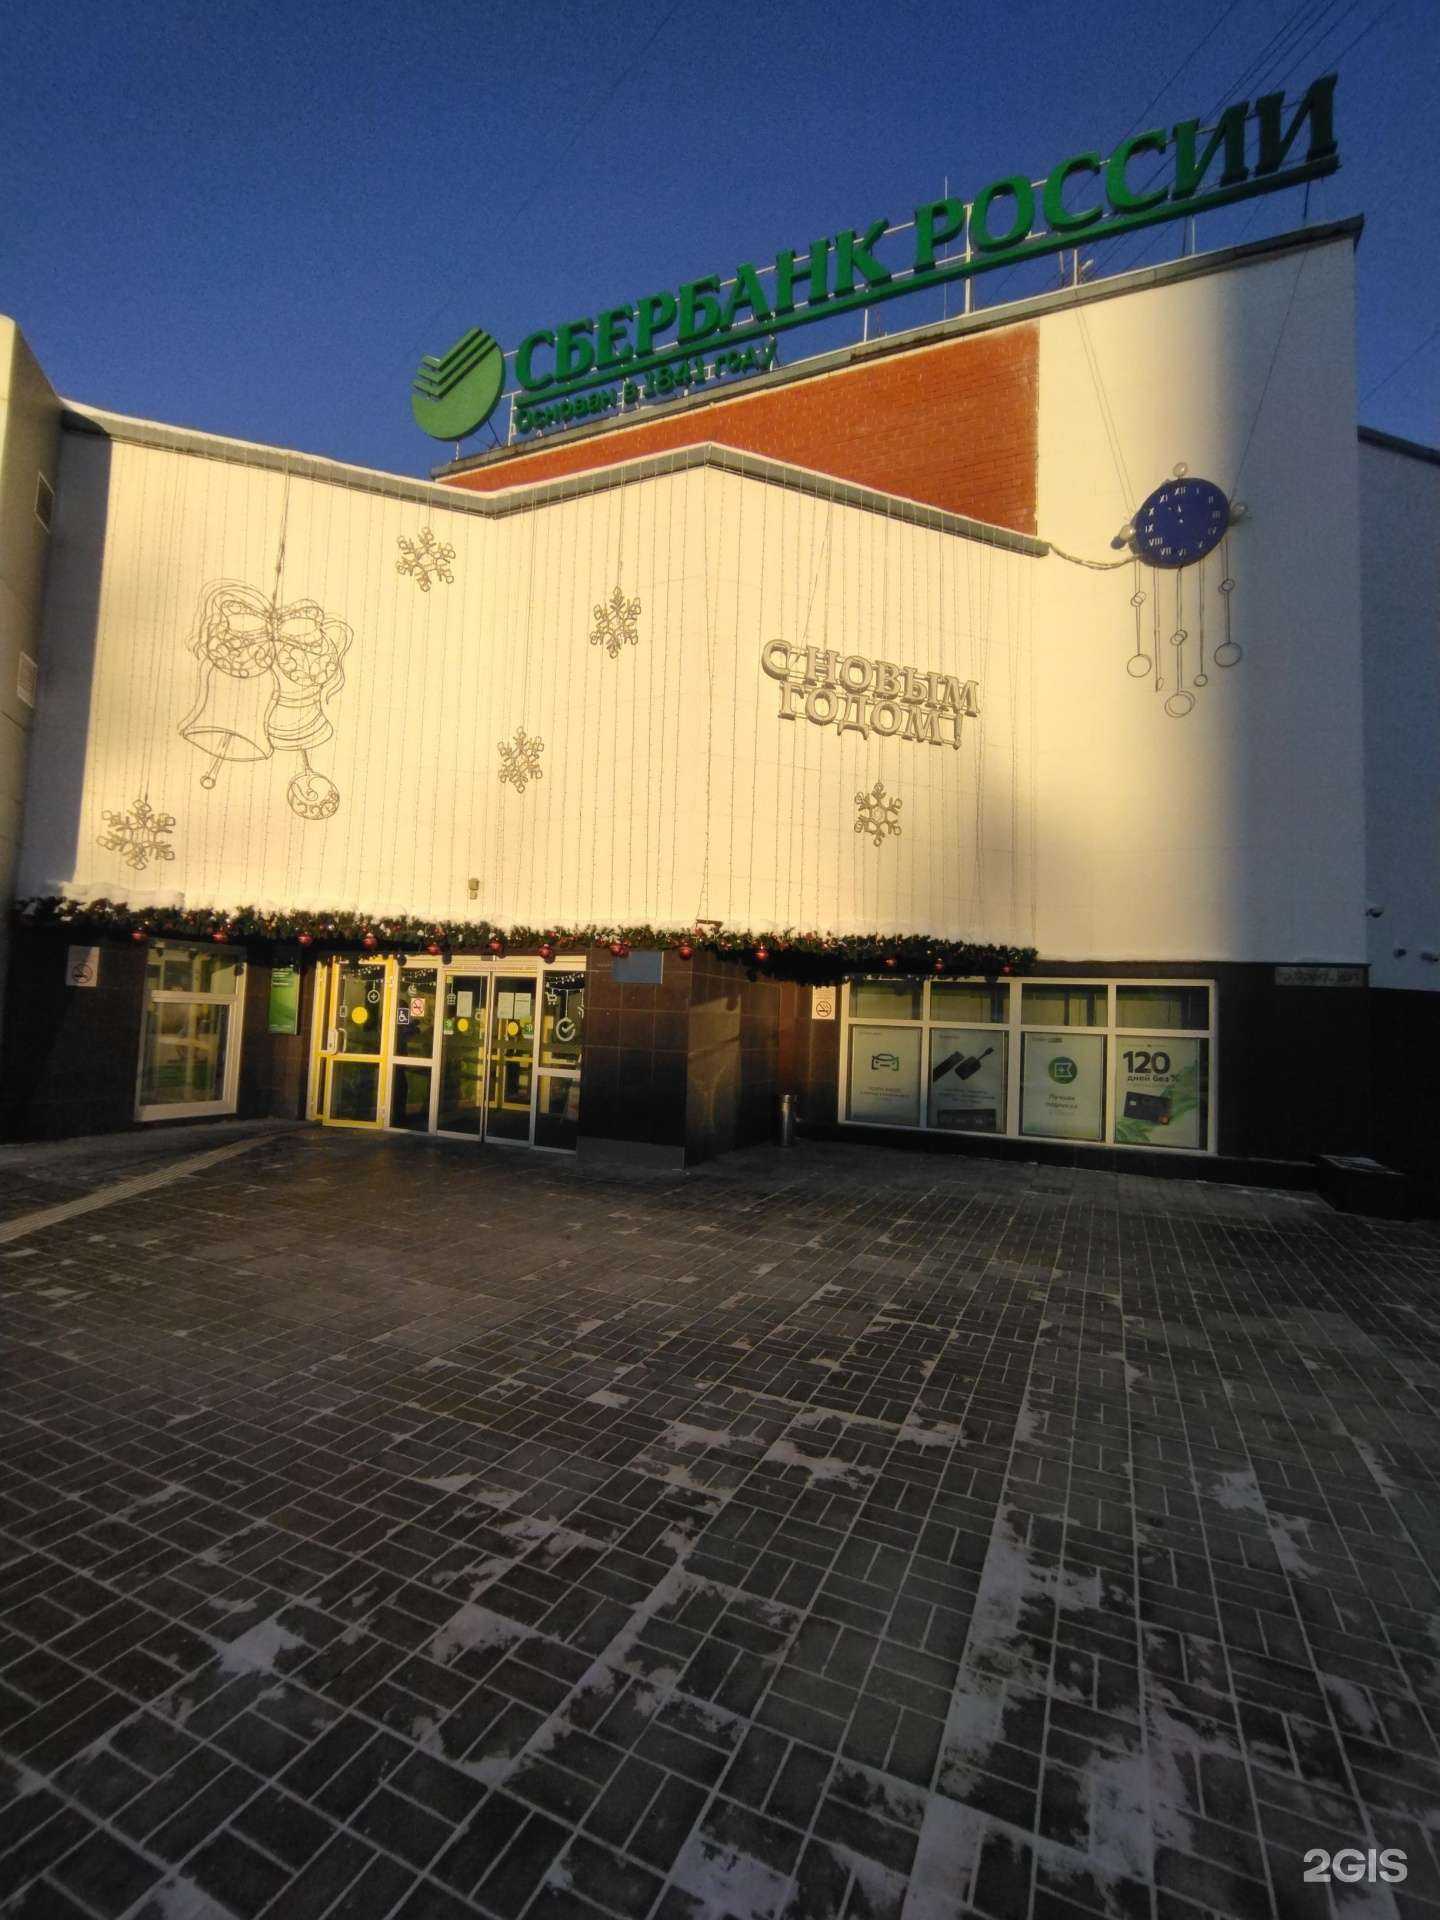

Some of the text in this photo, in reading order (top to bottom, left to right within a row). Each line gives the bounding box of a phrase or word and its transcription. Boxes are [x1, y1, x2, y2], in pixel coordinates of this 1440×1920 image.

[515, 73, 1337, 390] СБЕРБАНК РОССИИ
[516, 387, 619, 434] Основан
[644, 356, 707, 397] 1841
[713, 335, 778, 379] году
[777, 680, 964, 750] ГОДОМ!
[804, 644, 980, 717] НОВЫМ
[1122, 1050, 1171, 1075] 120
